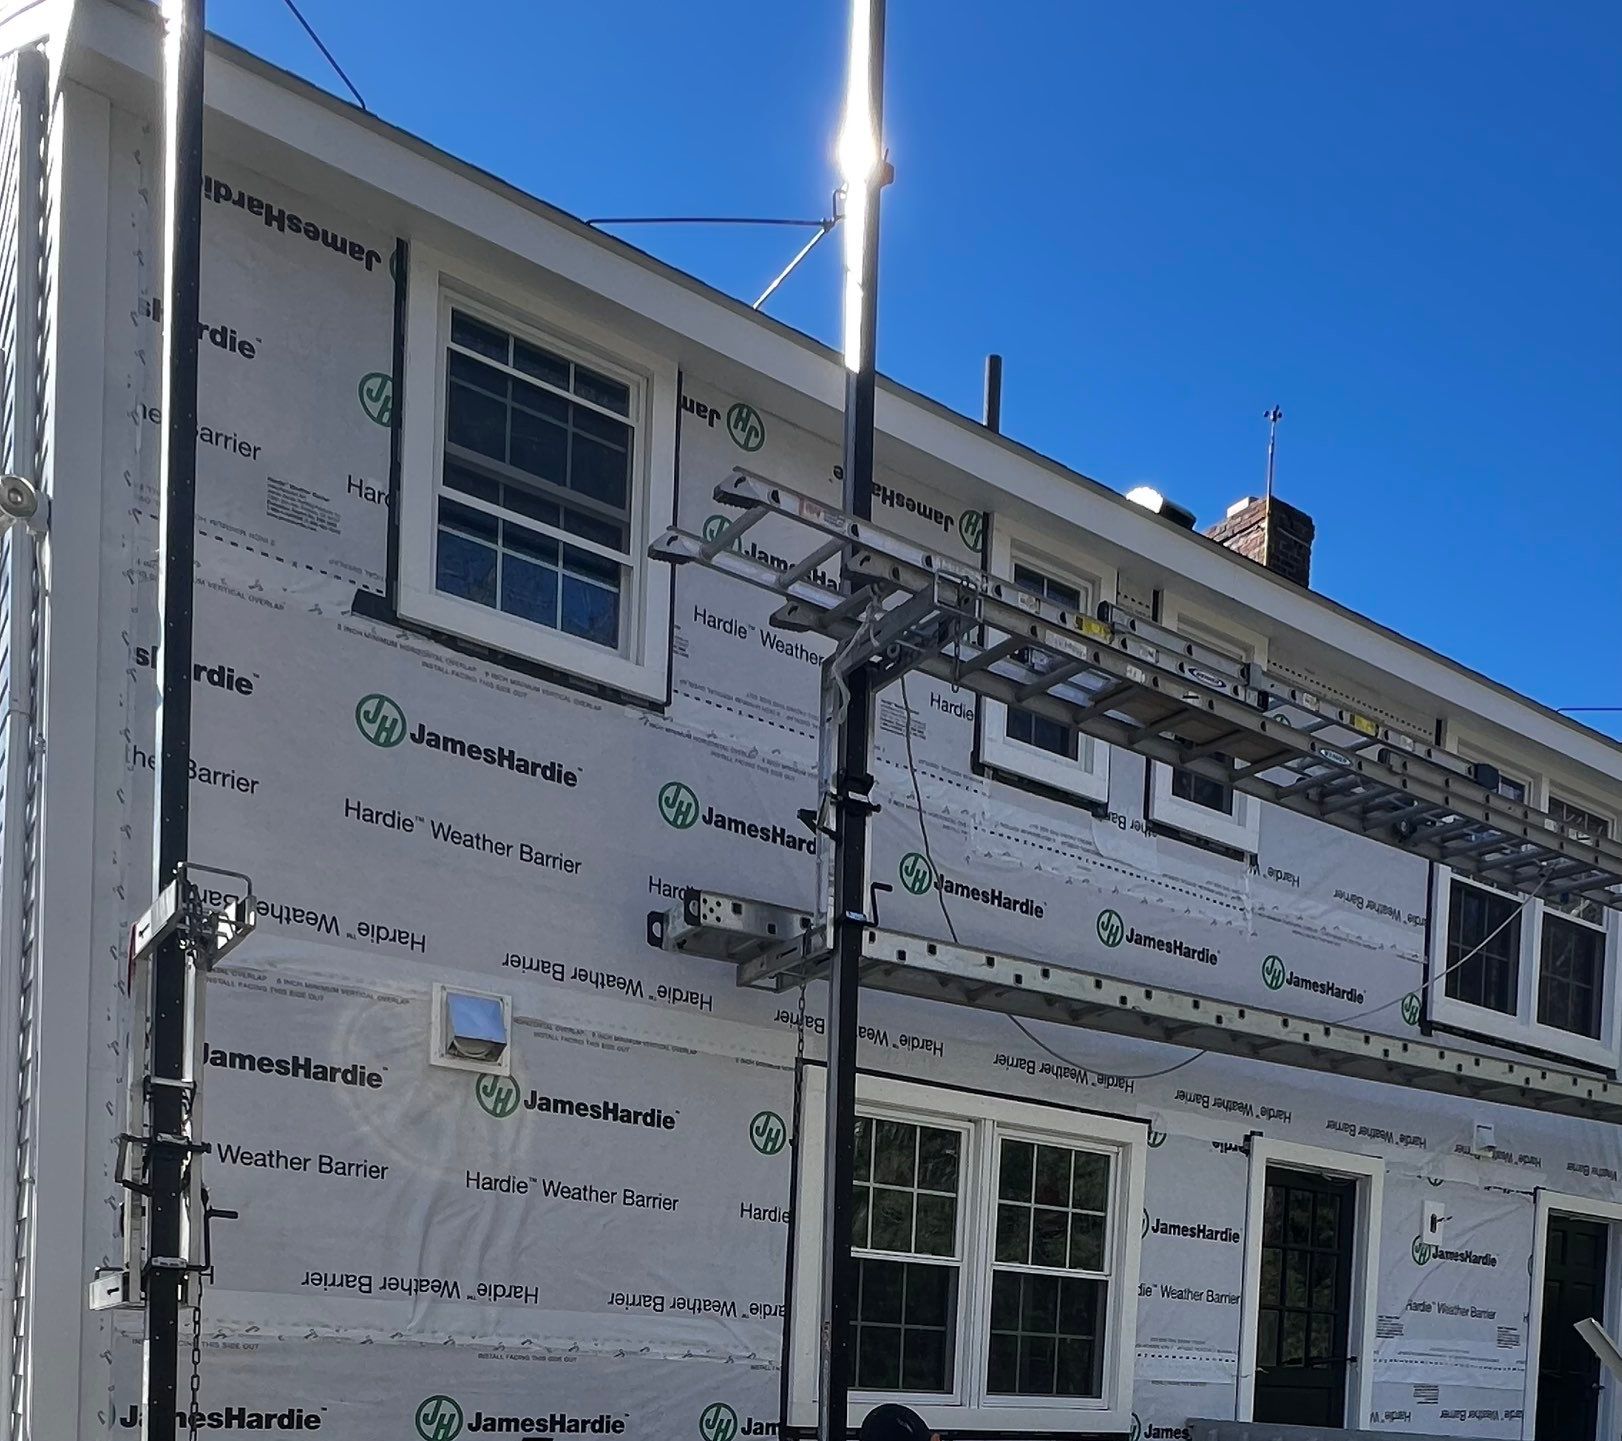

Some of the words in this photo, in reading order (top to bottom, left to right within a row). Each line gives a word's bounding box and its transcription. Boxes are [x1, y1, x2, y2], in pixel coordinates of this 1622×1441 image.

[203, 174, 381, 271] JamesHardi
[195, 424, 261, 460] arrier
[760, 628, 825, 667] Weather
[430, 819, 513, 858] Weather
[519, 843, 582, 875] Barrier
[502, 952, 565, 982] Barrier
[570, 968, 643, 998] Weather
[993, 1053, 1036, 1075] Barrier
[1038, 1063, 1088, 1086] Weather
[217, 1143, 312, 1173] Weather
[318, 1154, 389, 1180] Barrier
[542, 1178, 617, 1205] Weather
[622, 1187, 679, 1212] Barrier
[301, 1270, 373, 1294] Barrier
[379, 1276, 460, 1300] Weather
[1159, 1284, 1204, 1303] Weather
[608, 1290, 665, 1313] Barrier
[669, 1295, 737, 1318] Weather
